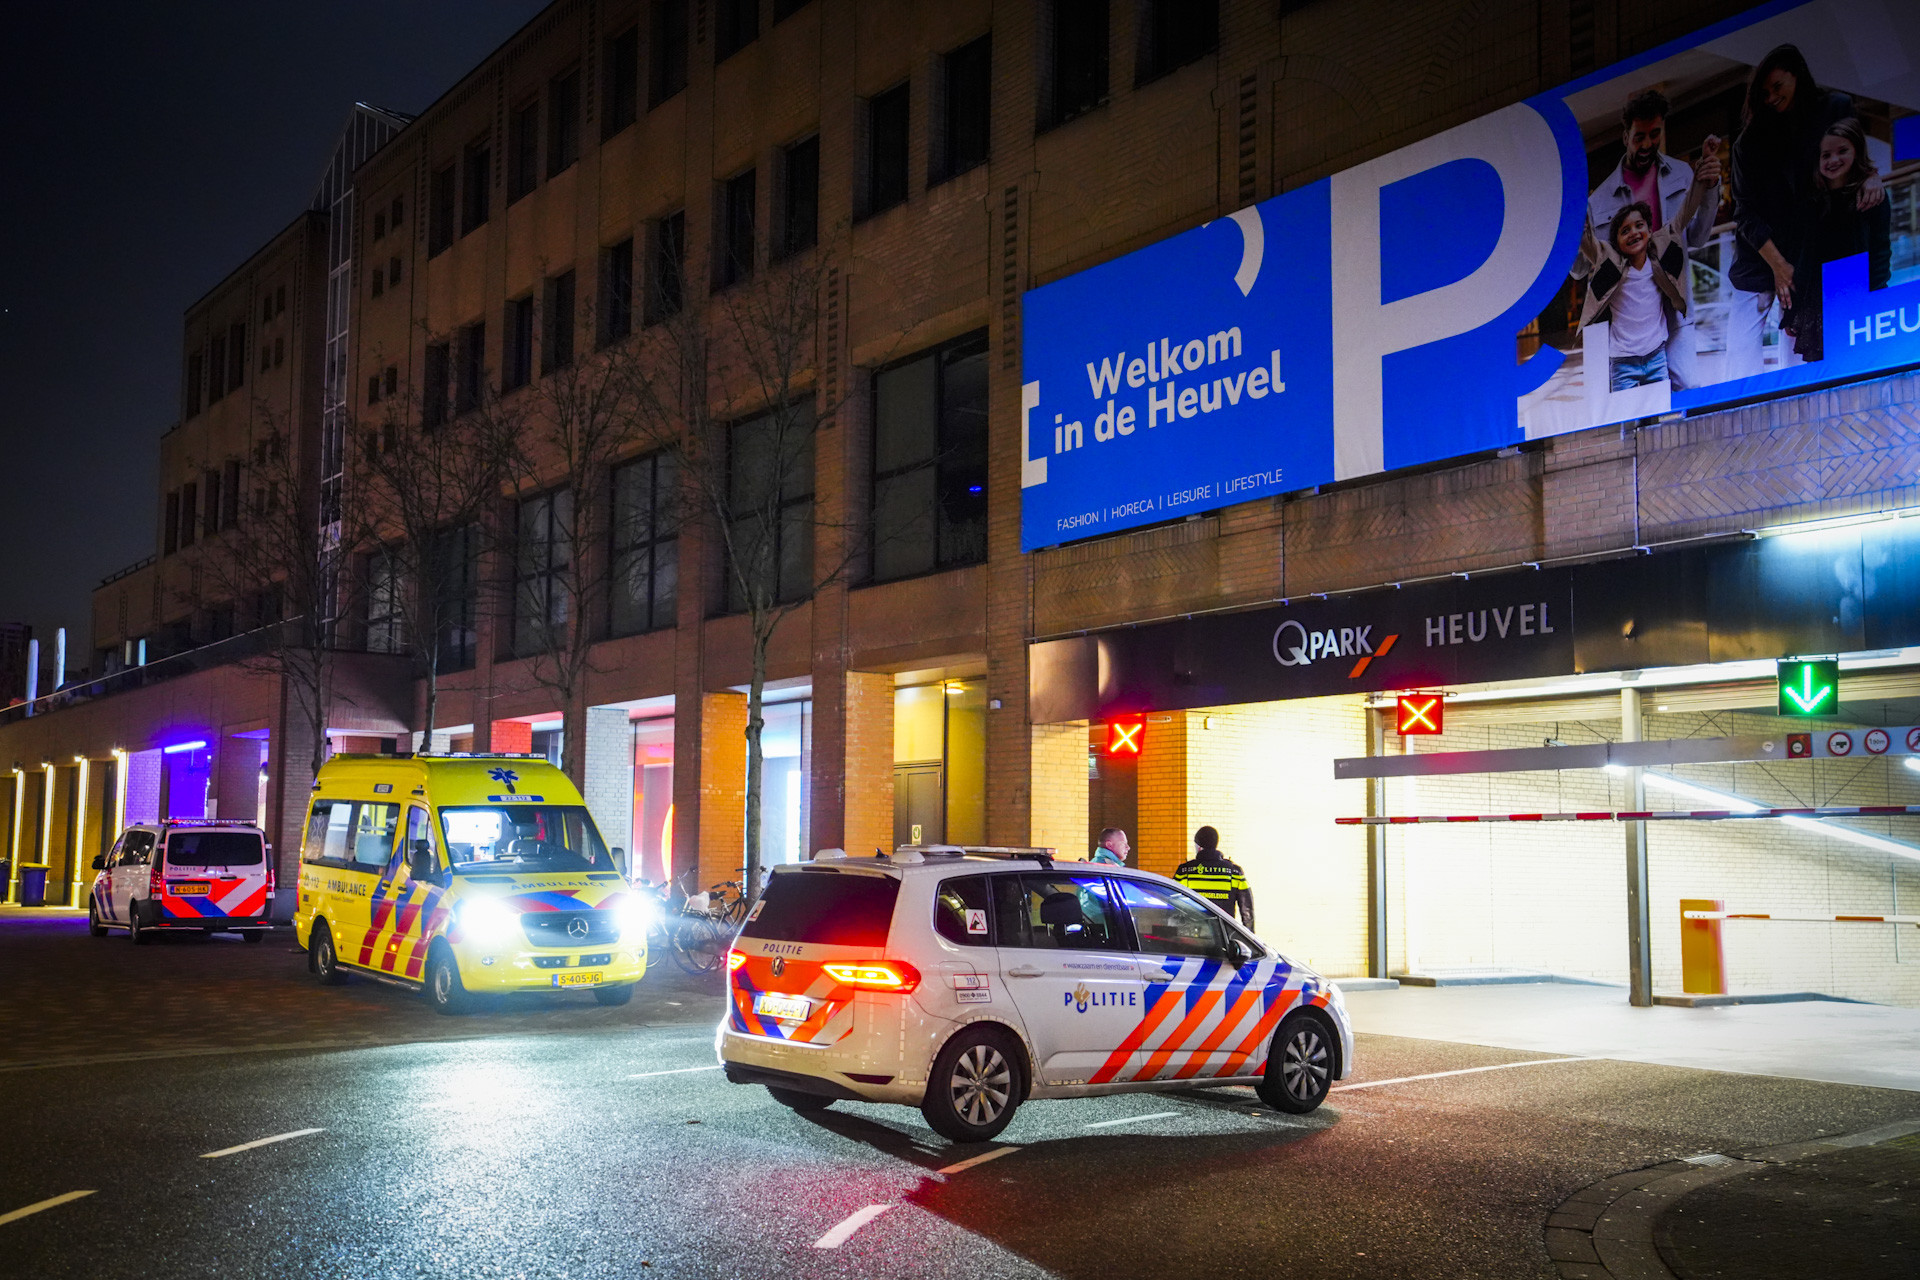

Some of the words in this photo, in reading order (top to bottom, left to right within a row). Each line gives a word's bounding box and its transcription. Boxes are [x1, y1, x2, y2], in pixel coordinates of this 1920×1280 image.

[1086, 326, 1242, 400] Welkom
[1055, 413, 1084, 454] in
[1094, 399, 1136, 442] de
[1148, 349, 1286, 429] Heuvel
[1057, 510, 1099, 531] FASHION
[1111, 499, 1154, 518] HORECA
[1167, 485, 1211, 507] LEISURE
[1225, 468, 1283, 494] LIFESTYLE
[1425, 602, 1554, 648] HEUVEL
[1193, 865, 1226, 874] POLITIE
[327, 879, 367, 897] AMBULANCE
[511, 881, 608, 890] AMBULANCE
[763, 943, 803, 955] POLITIE
[560, 973, 600, 984] S-405-JG
[1064, 992, 1136, 1014] POLITIE
